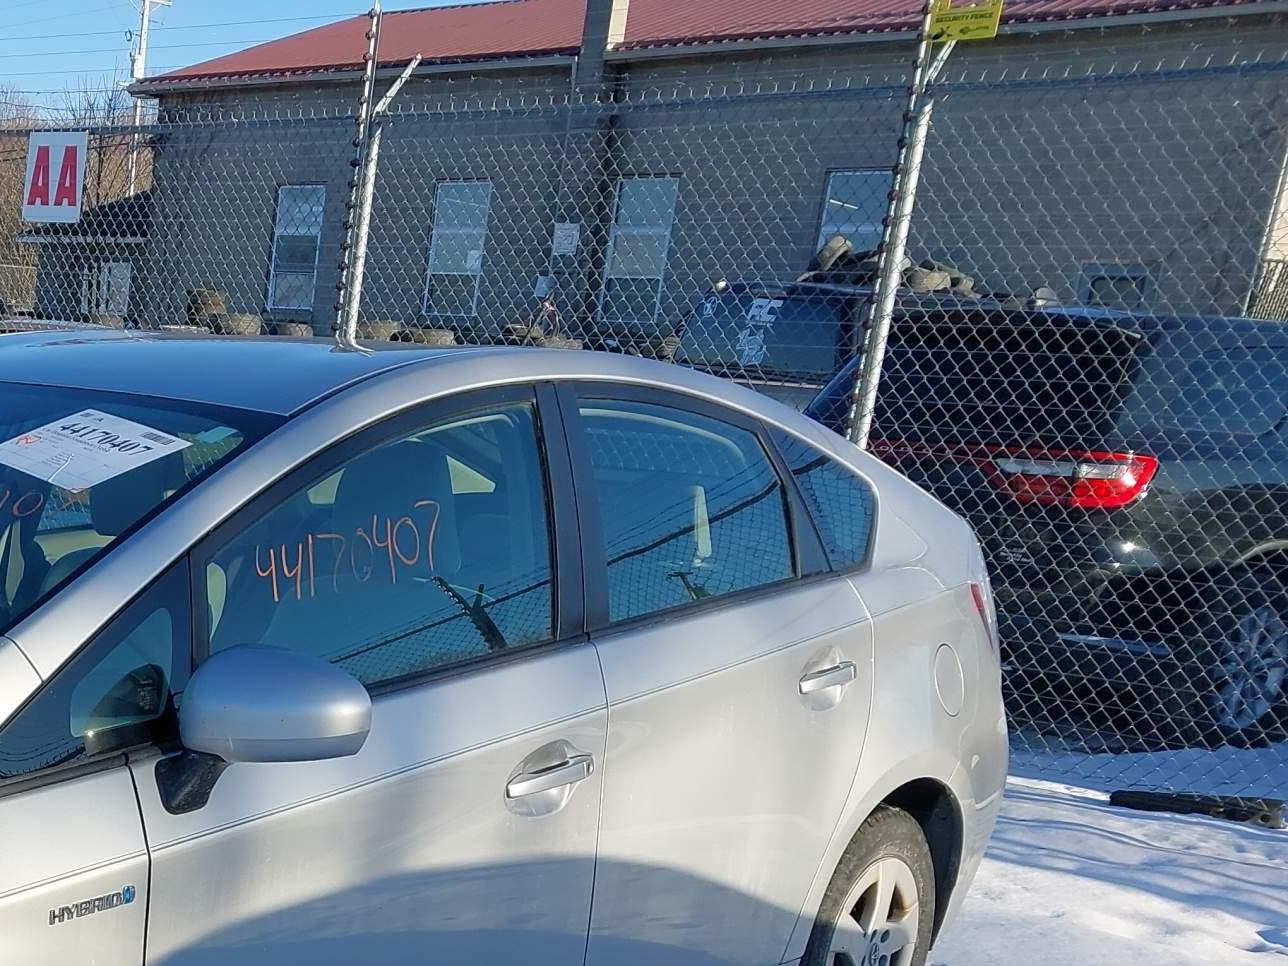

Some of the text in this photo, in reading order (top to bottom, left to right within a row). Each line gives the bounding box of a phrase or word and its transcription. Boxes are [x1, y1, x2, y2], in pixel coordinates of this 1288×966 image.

[27, 145, 78, 206] AA
[59, 422, 155, 456] 44170407
[255, 500, 440, 602] 44170407
[48, 891, 123, 926] HYBRID
